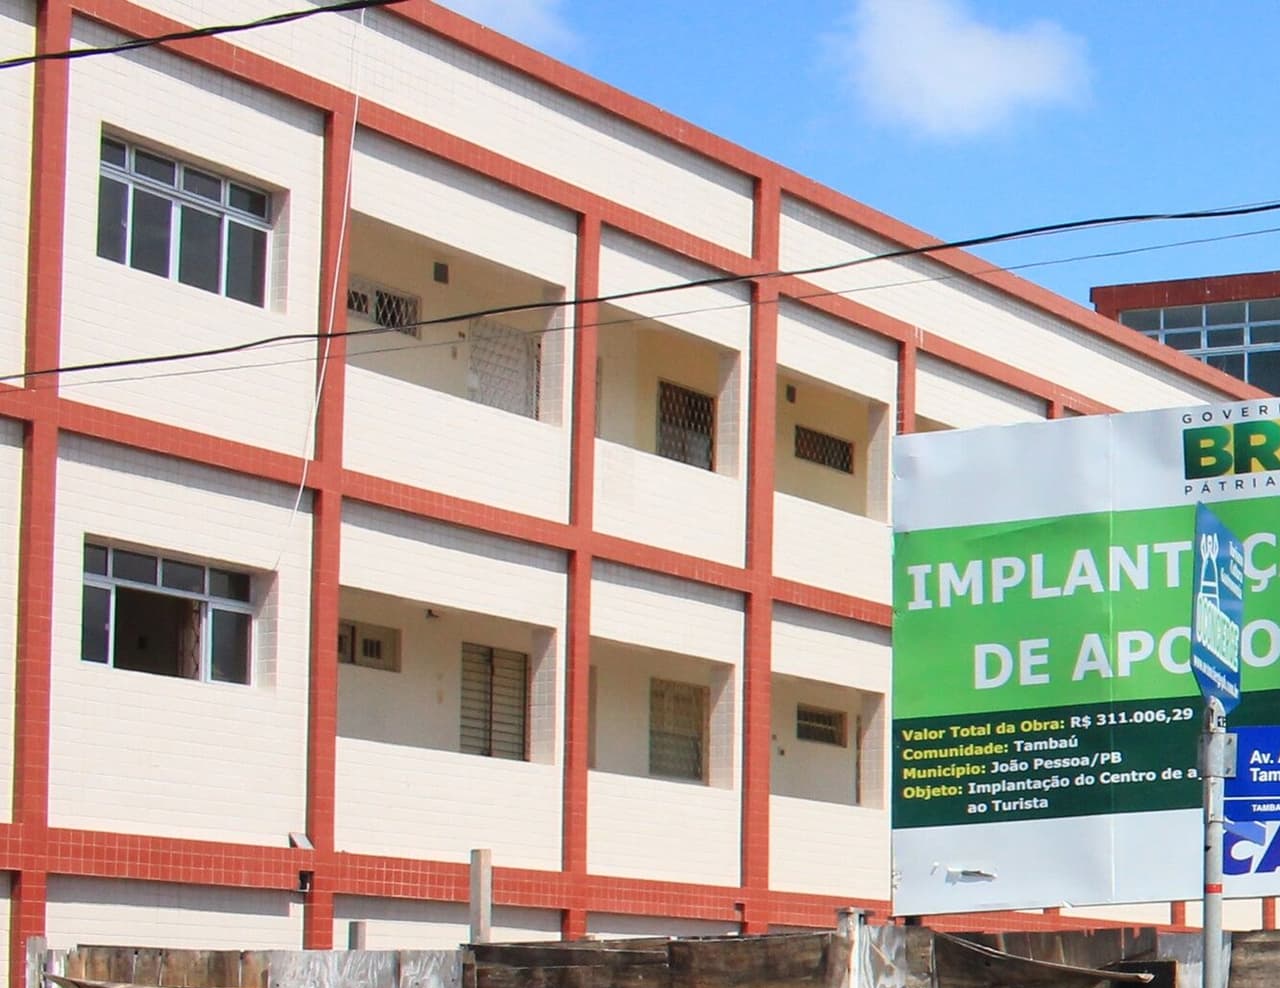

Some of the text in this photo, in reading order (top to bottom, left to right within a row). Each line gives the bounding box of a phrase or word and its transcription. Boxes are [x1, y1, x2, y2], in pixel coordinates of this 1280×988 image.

[1184, 475, 1277, 495] PÁTRIA
[974, 638, 1051, 690] DE
[902, 708, 1193, 742] Valor Total da Obra: R$ 311.006,29
[902, 735, 1078, 761] Comunidade: Tambaú
[1250, 750, 1274, 764] Av.
[903, 752, 1122, 781] Município: João Pessoa/PB
[904, 783, 963, 800] Objeto:
[967, 775, 1069, 796] Implantação
[1075, 773, 1095, 786] do
[1100, 769, 1156, 784] Centro
[1161, 767, 1183, 780] de
[967, 797, 1048, 814] ao Turista
